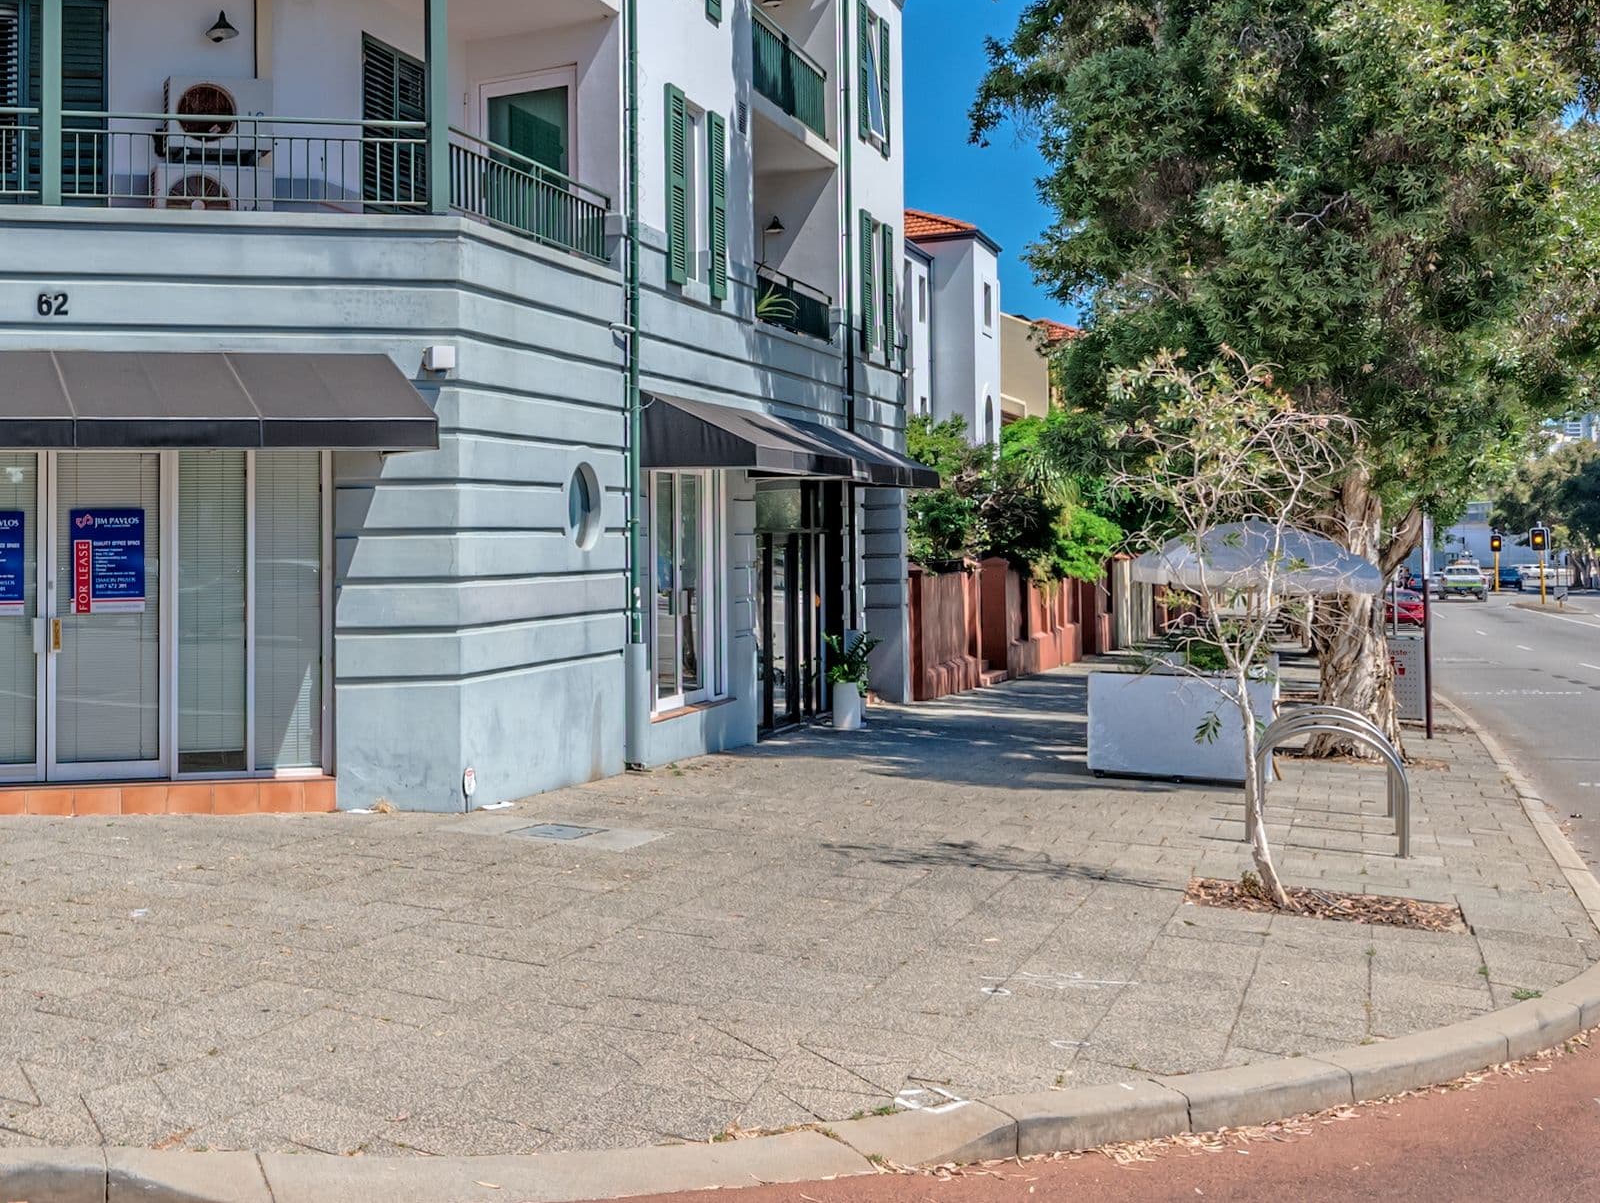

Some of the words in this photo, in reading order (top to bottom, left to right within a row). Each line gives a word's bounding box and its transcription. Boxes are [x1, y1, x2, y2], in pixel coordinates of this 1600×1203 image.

[36, 292, 69, 317] 62
[94, 517, 108, 529] JIM
[109, 516, 140, 524] PAVLOS
[78, 543, 89, 580] LEASE
[78, 585, 89, 611] FOR
